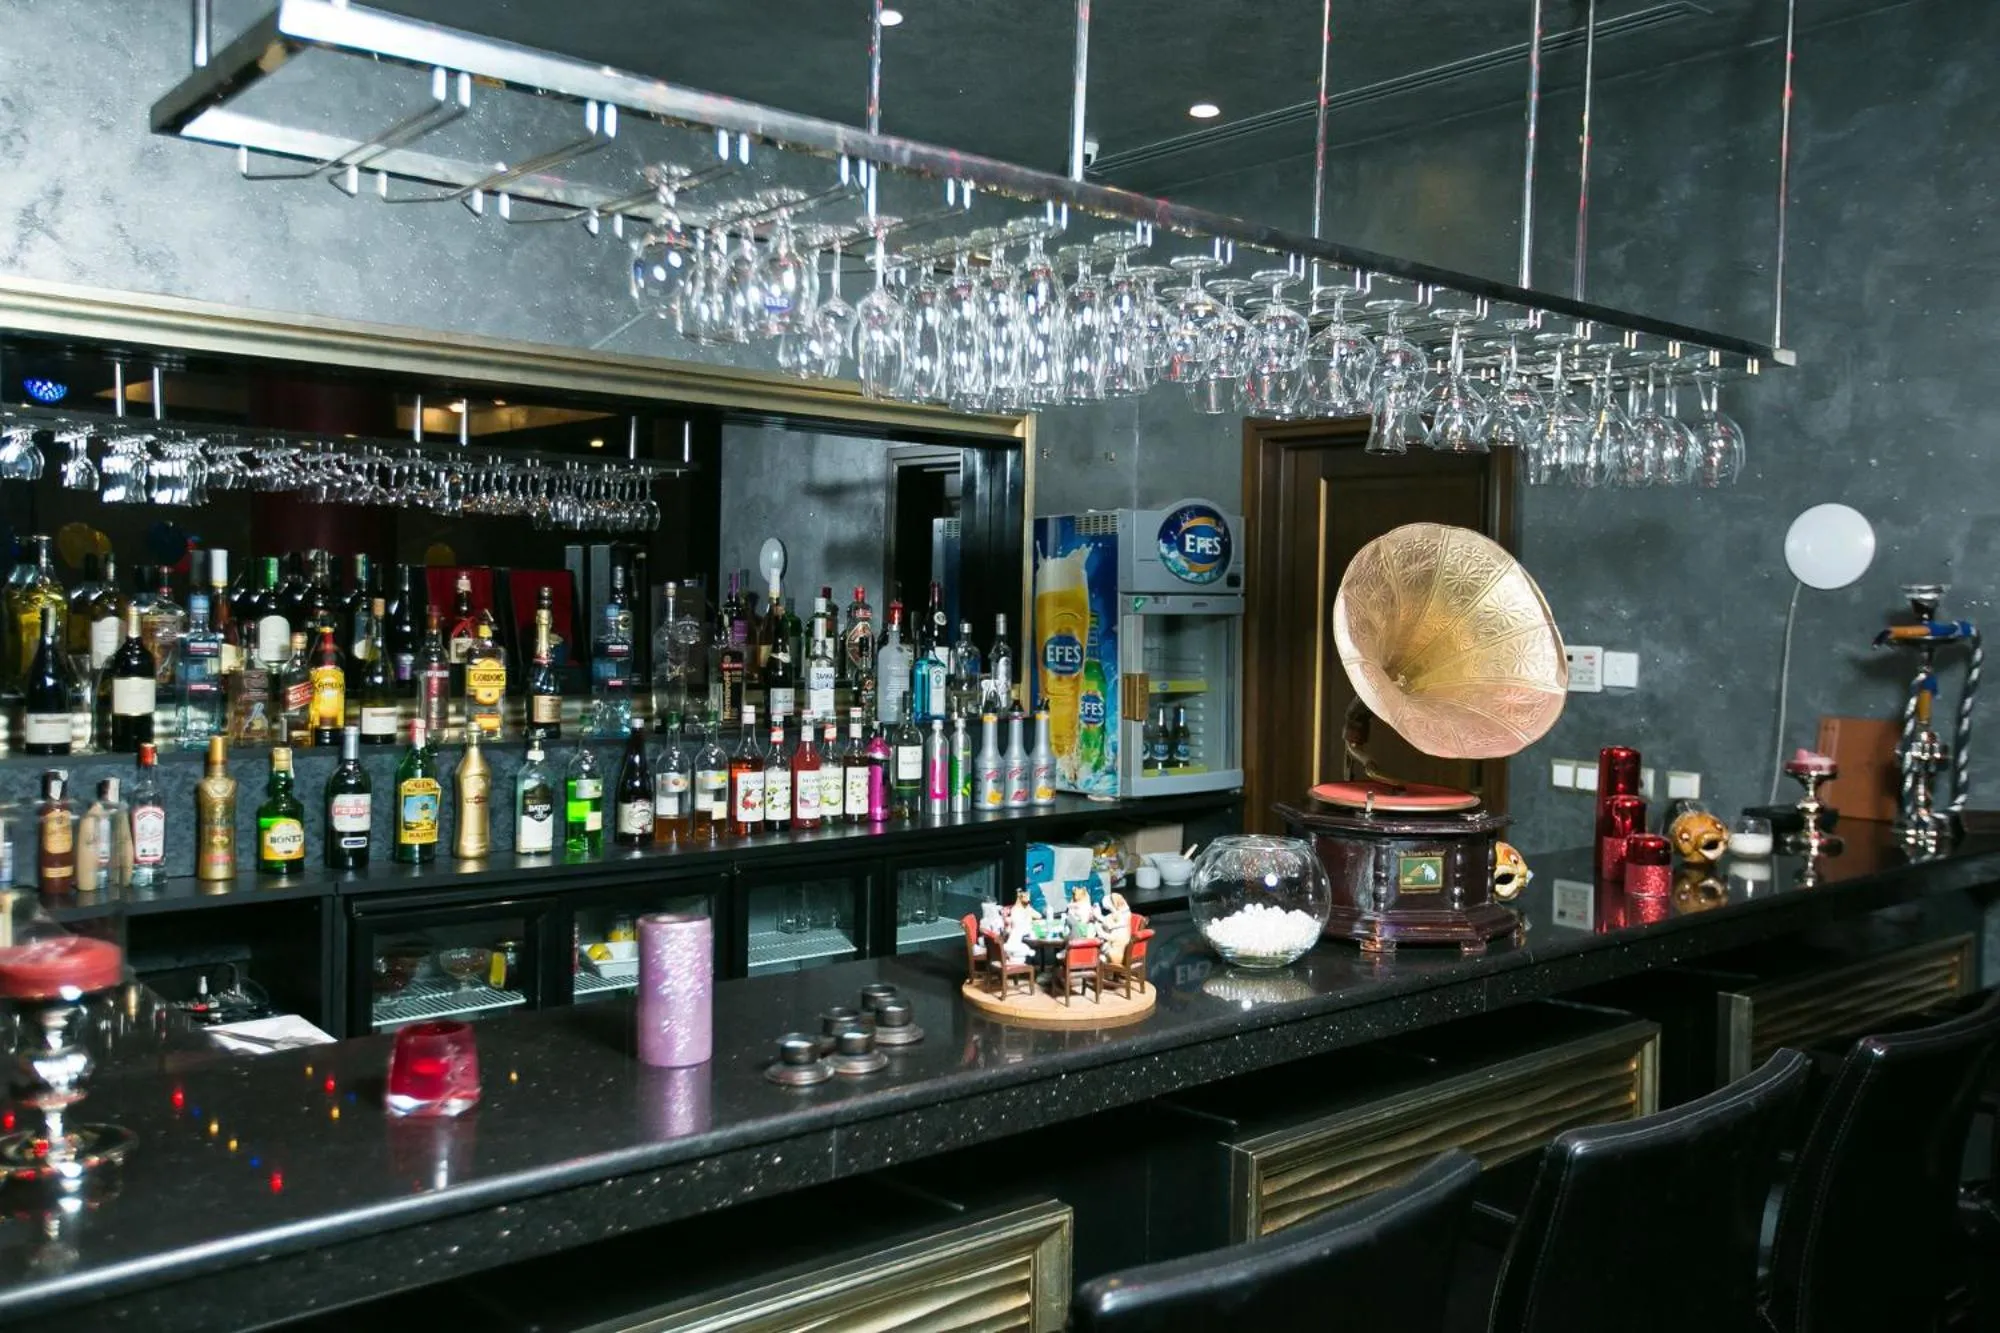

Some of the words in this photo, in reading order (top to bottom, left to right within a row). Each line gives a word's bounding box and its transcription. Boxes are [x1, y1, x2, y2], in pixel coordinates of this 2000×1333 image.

[1184, 533, 1221, 555] EFES
[1046, 644, 1081, 663] EFES
[1080, 702, 1104, 715] EFES
